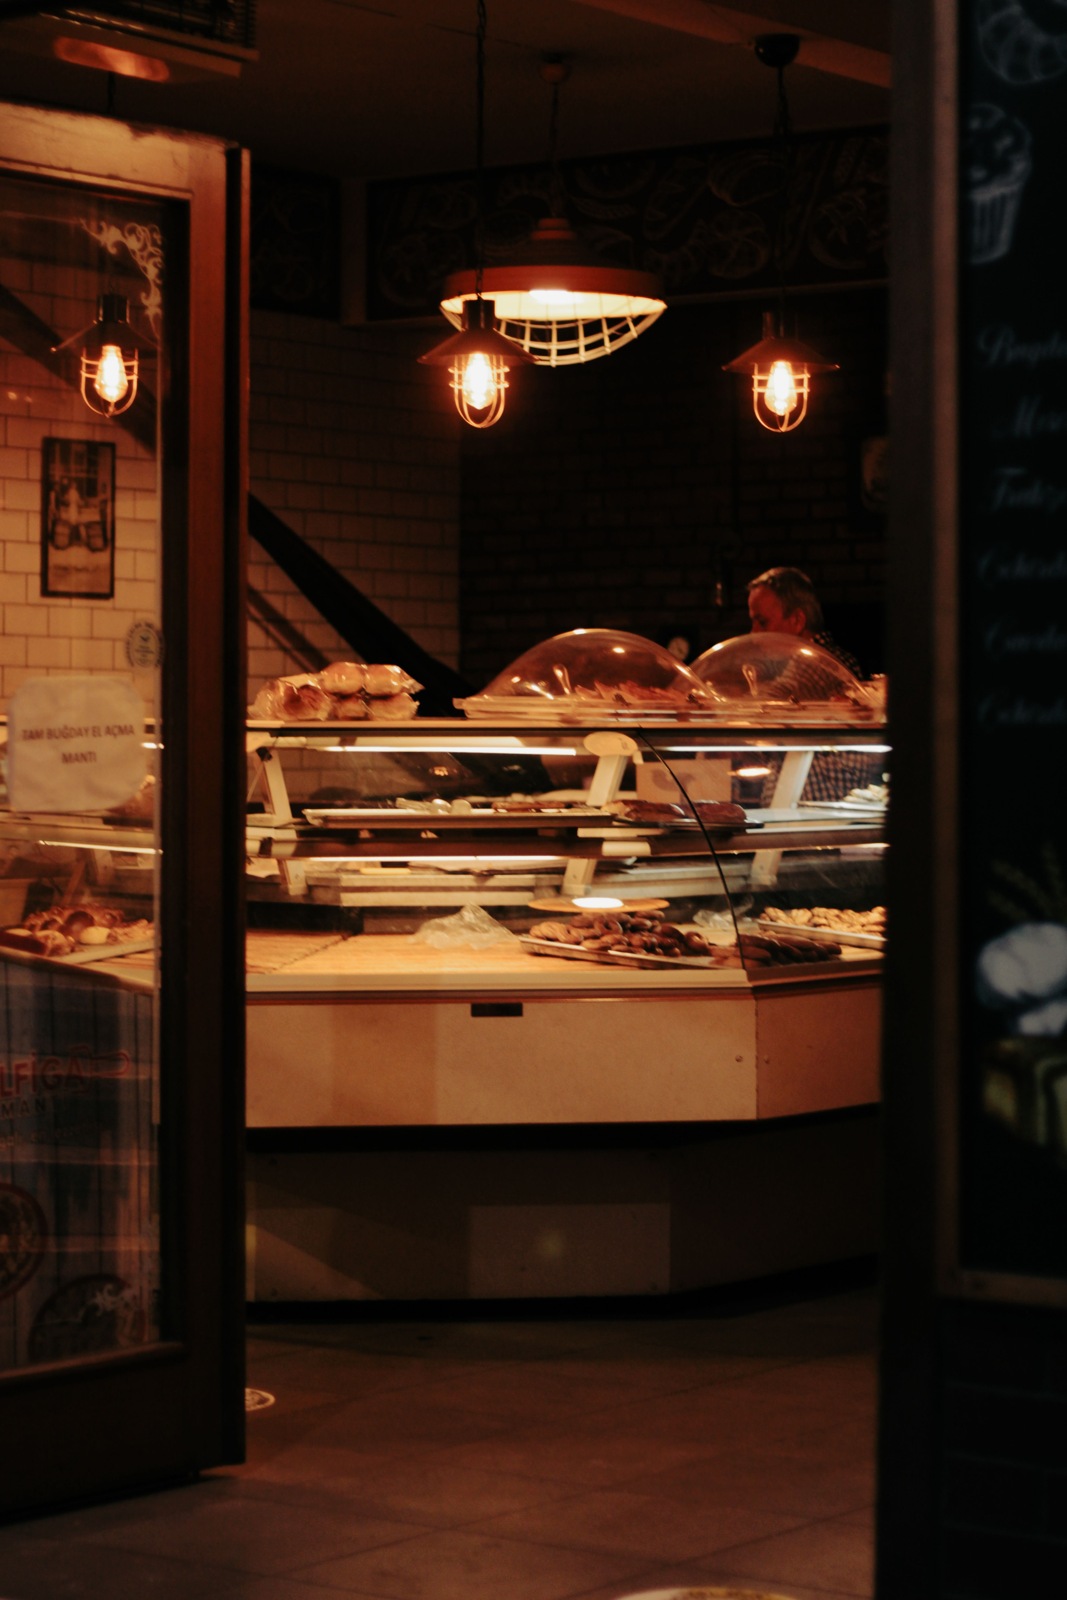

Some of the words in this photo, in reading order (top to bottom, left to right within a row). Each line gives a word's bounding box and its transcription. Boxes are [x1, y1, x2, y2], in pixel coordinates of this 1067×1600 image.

[22, 729, 44, 741] TAM
[46, 725, 89, 740] BUĞDAY
[92, 725, 102, 738] EL
[105, 724, 135, 739] AÇMA
[61, 751, 97, 764] MANTI
